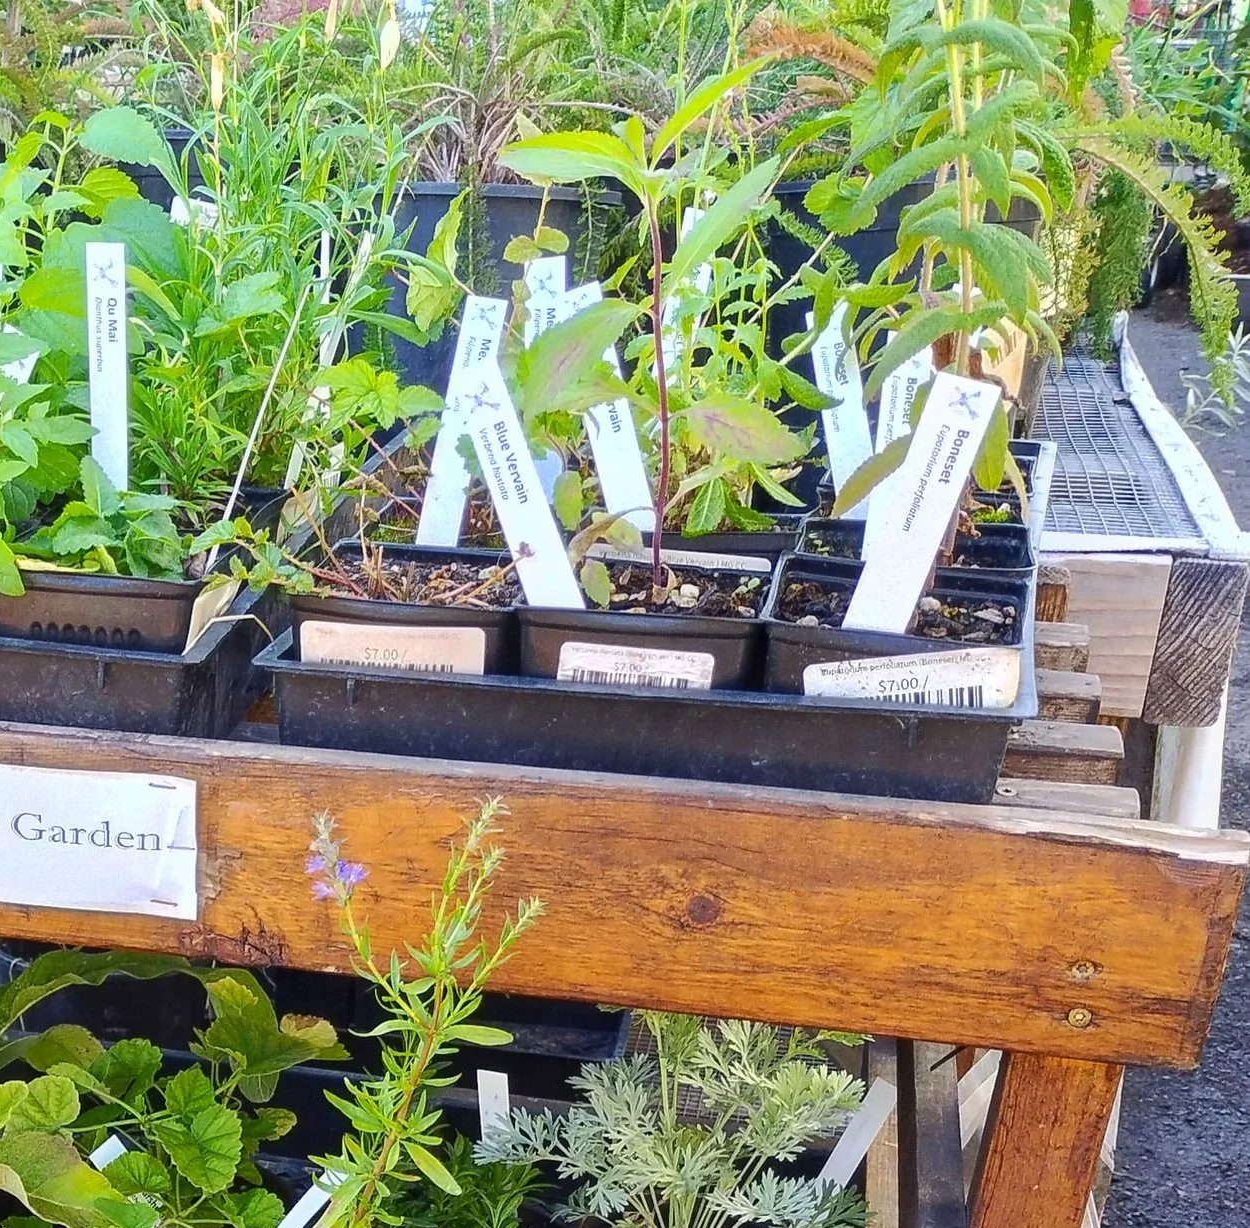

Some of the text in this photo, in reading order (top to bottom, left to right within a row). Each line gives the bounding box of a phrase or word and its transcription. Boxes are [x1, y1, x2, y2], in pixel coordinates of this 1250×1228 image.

[95, 296, 104, 373] Dianthus superbus
[107, 297, 118, 343] Qu Mai
[833, 342, 849, 386] Boeset
[608, 402, 622, 433] rvain
[888, 375, 901, 421] Eupatorium
[902, 377, 918, 425] Boneset
[479, 428, 496, 465] Verbena
[493, 421, 528, 504] Blue Vervain
[938, 429, 970, 485] Boneset
[902, 424, 950, 532] Eupatorium perfoliatum
[364, 647, 399, 661] $7.00
[614, 662, 642, 673] $7.00
[870, 659, 917, 672] perfoliatum
[878, 678, 918, 693] $7.00
[11, 812, 163, 852] Garden
